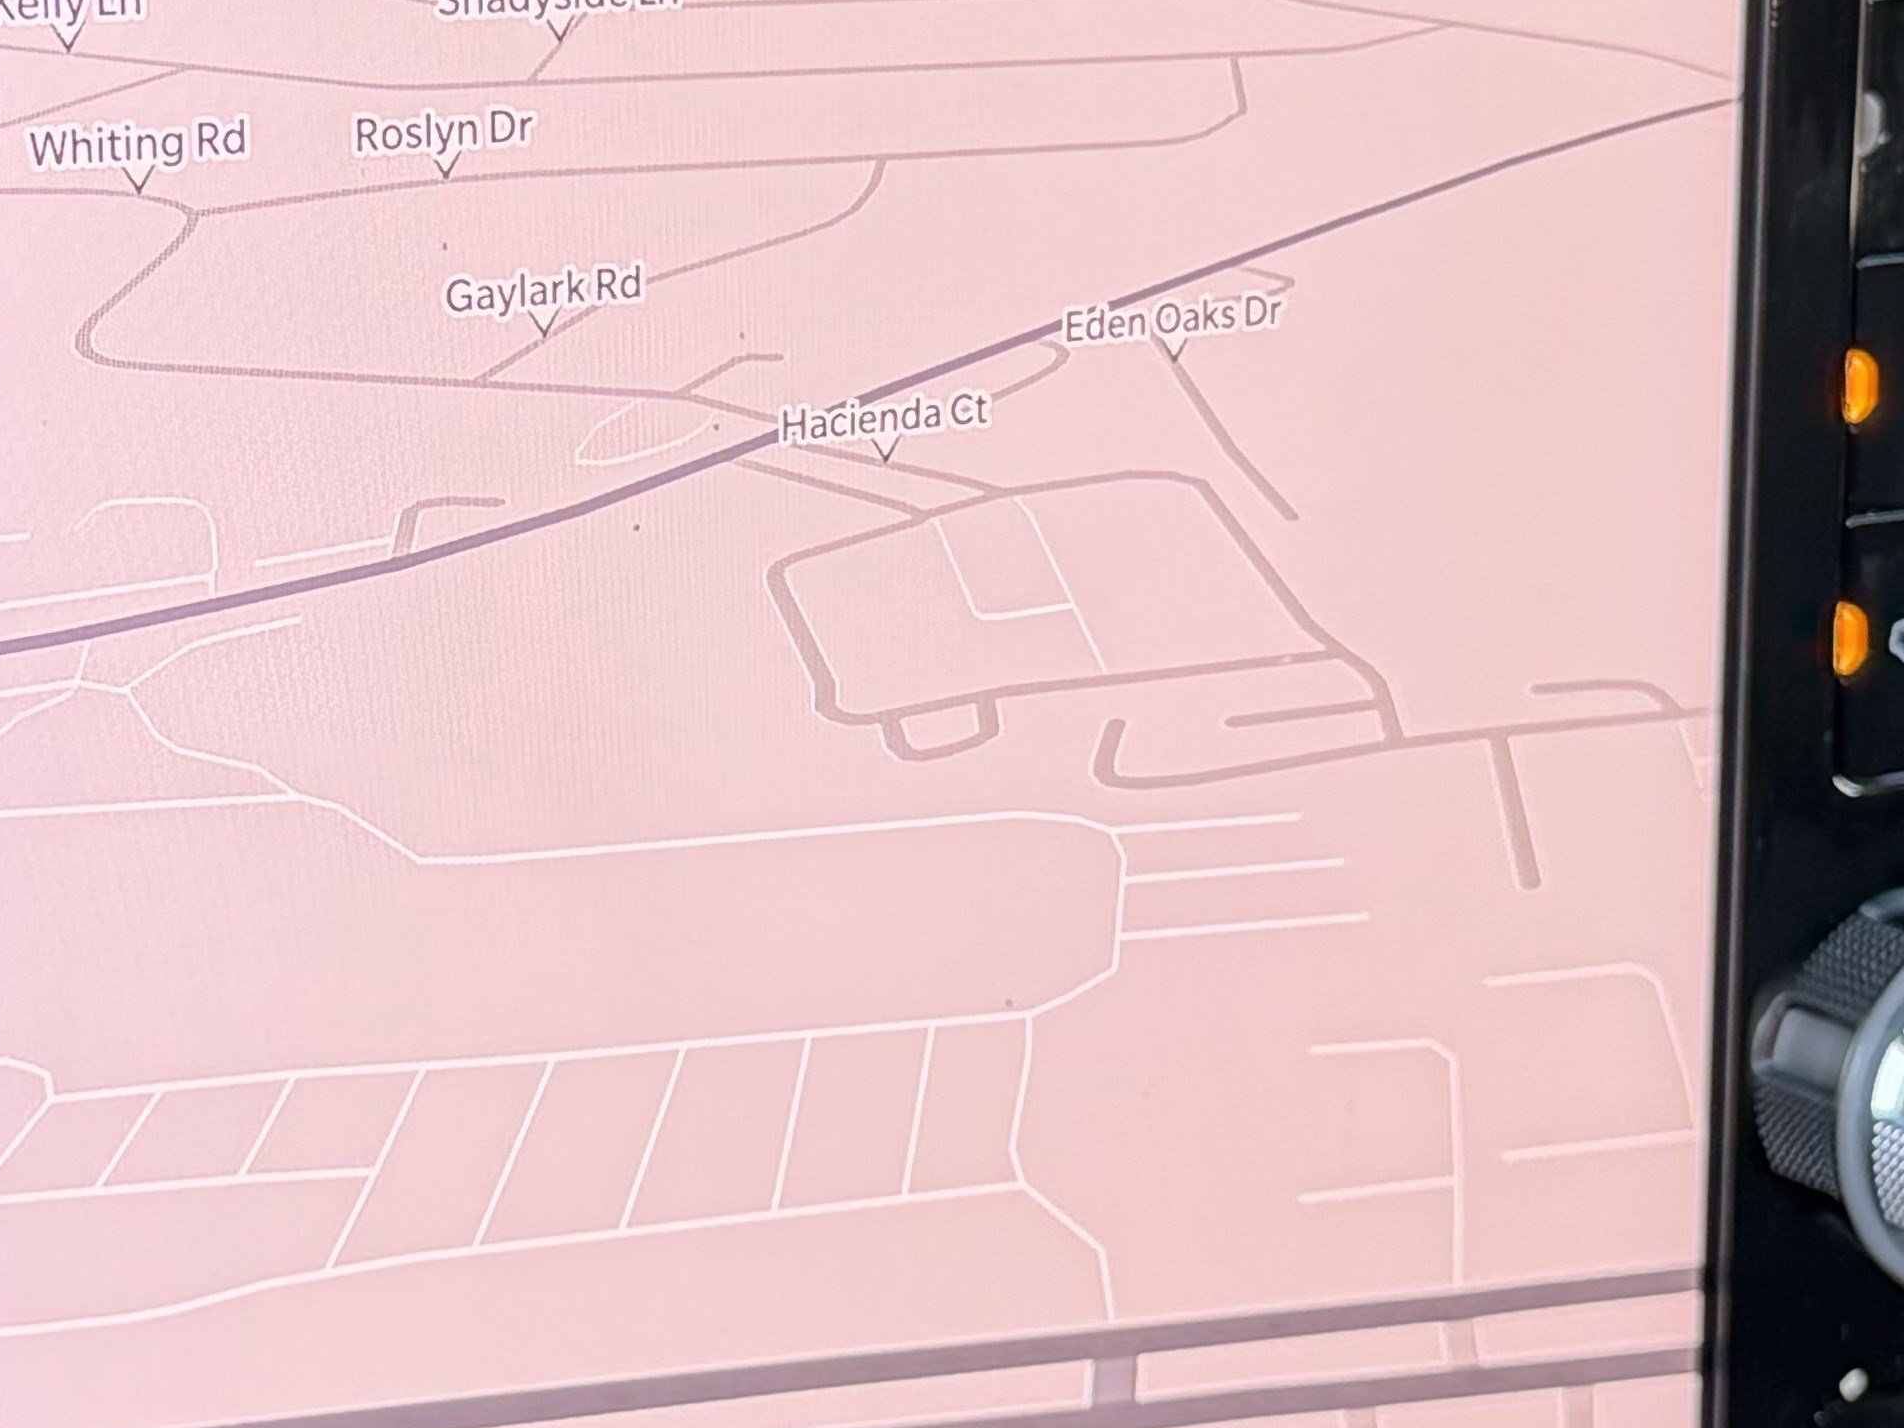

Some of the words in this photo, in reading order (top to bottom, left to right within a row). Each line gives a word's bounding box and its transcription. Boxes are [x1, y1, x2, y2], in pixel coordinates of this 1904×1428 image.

[29, 124, 185, 167] Whiting
[198, 121, 246, 158] Rd
[356, 112, 479, 155] Roslyn
[490, 110, 534, 143] Dr
[446, 270, 586, 320] Gaylark
[597, 266, 643, 302] Rd
[1066, 308, 1146, 344] Eden
[1155, 302, 1236, 338] Oaks
[1245, 297, 1282, 330] Dr
[782, 401, 942, 442] Hacienda
[950, 396, 990, 430] Ct
